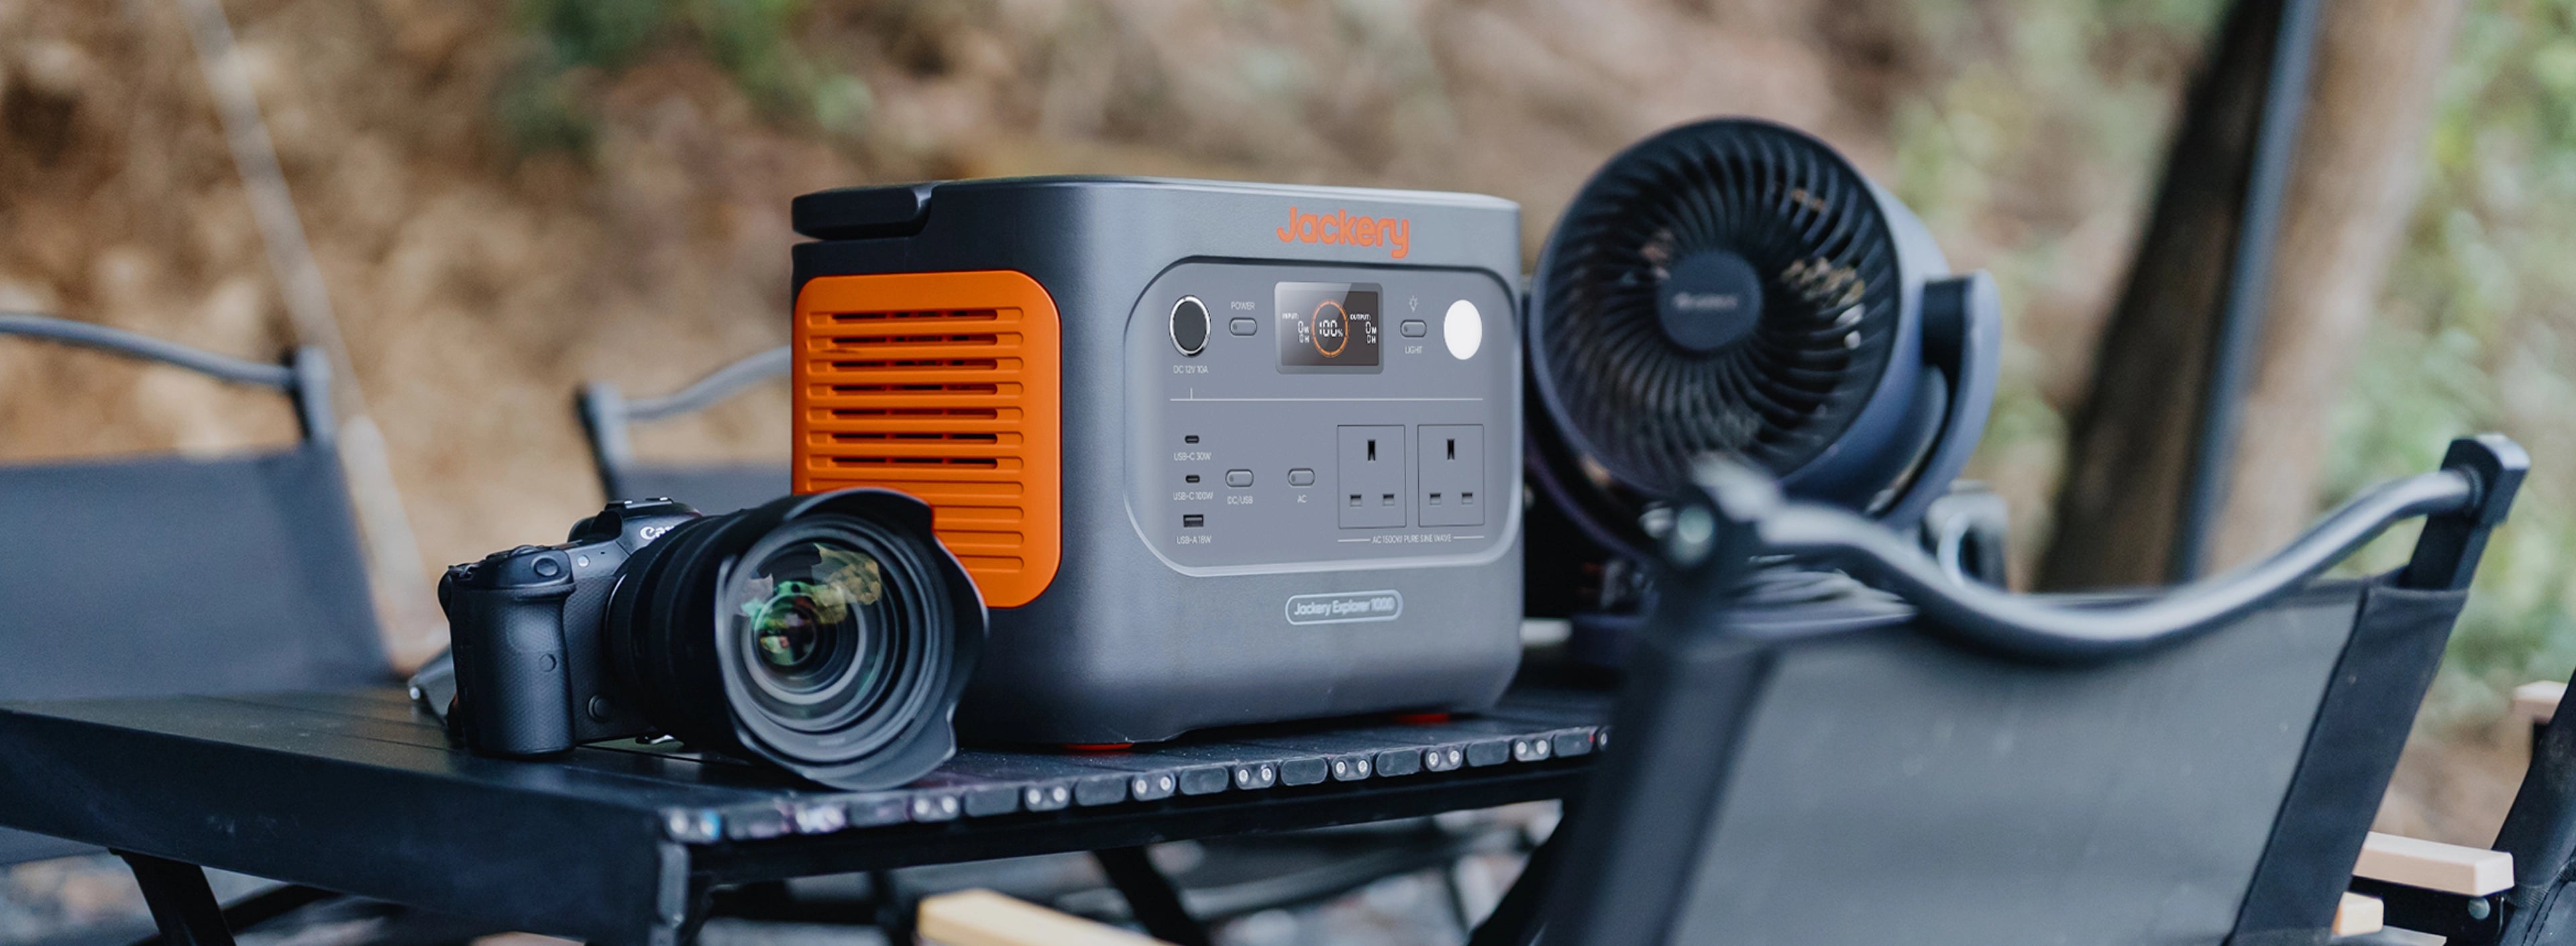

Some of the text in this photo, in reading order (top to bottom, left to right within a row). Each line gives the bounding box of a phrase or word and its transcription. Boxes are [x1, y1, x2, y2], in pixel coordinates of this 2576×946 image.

[1277, 206, 1409, 259] Jackery
[1230, 301, 1256, 311] POWER
[1404, 346, 1422, 354] LIGHT
[1173, 365, 1184, 374] DC
[1185, 365, 1196, 374] 12V
[1173, 452, 1212, 461] USB-C 30W
[1173, 491, 1214, 501] USB-C 100W
[1227, 495, 1254, 505] DC/USB
[1297, 494, 1307, 503] AC
[639, 525, 675, 540] Ca
[1176, 535, 1197, 545] USB-A
[1293, 602, 1332, 617] Jackery
[1332, 599, 1371, 615] Explorer
